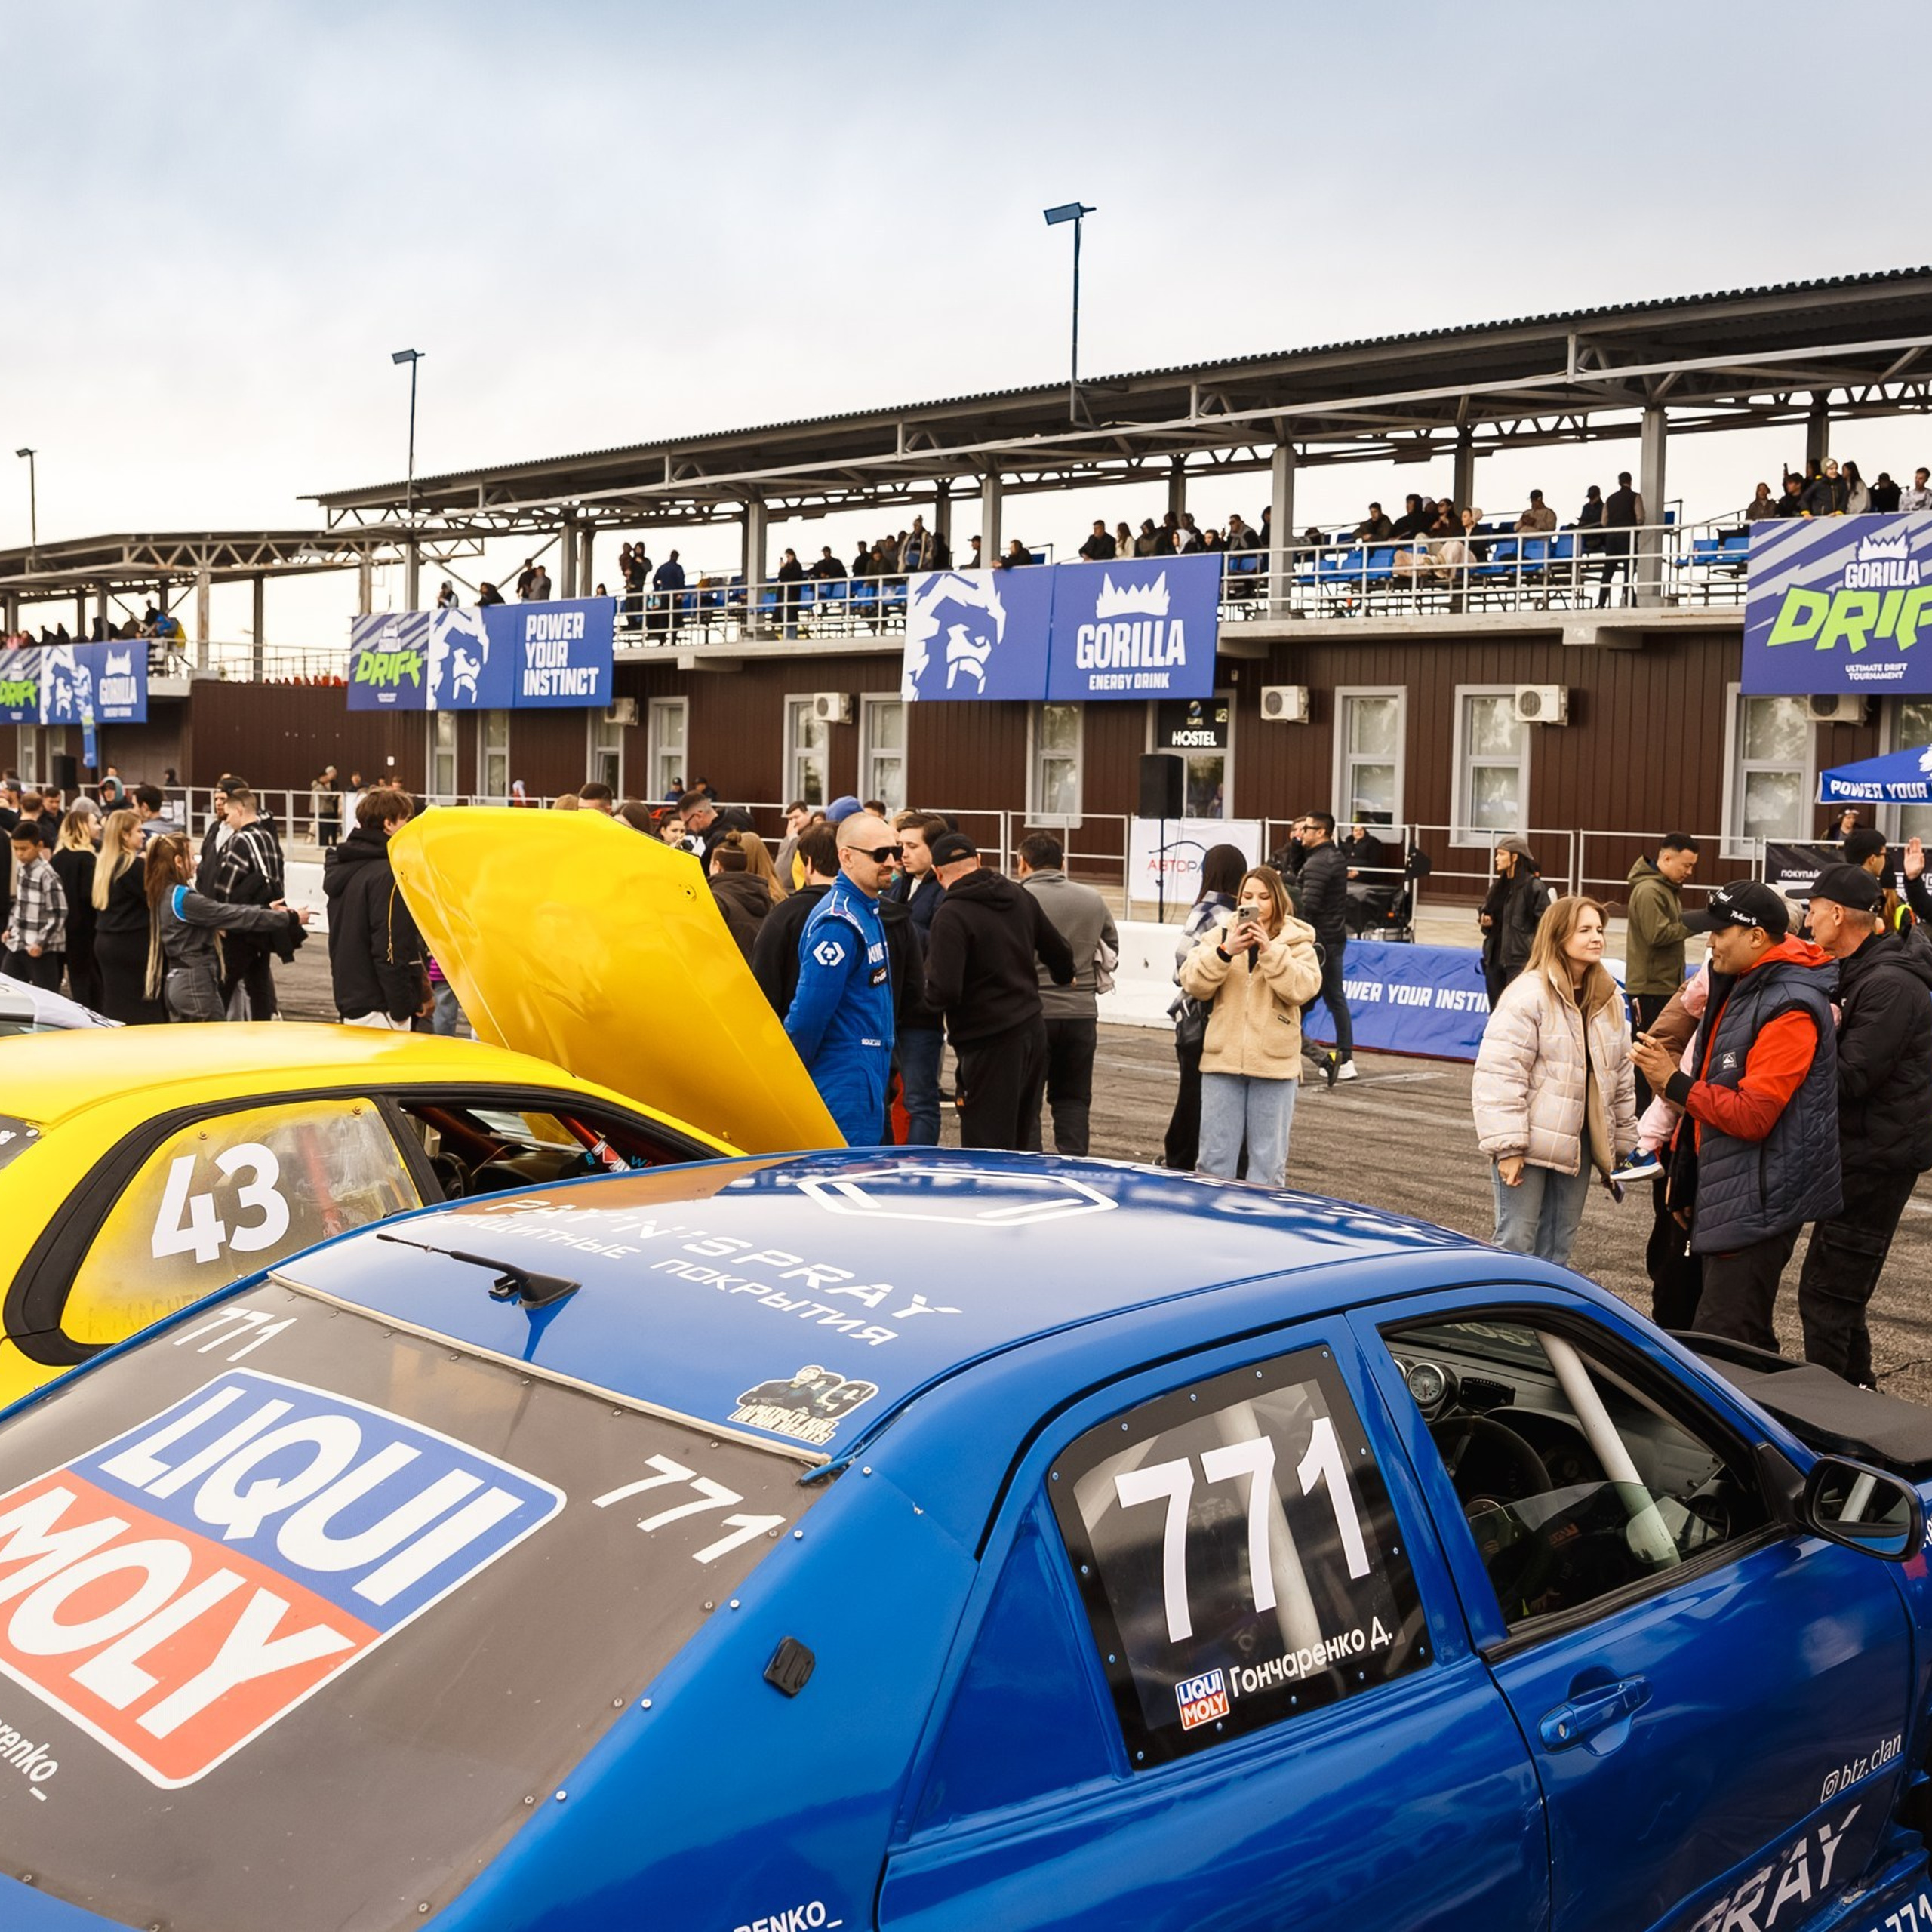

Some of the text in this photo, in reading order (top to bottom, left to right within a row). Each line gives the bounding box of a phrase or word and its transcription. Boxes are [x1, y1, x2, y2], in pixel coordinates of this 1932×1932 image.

[1845, 559, 1920, 589] GORILLA
[526, 612, 585, 640] POWER
[525, 641, 568, 668] YOUR
[1076, 619, 1186, 669] GORILLA
[355, 649, 423, 688] DRIFT
[523, 667, 599, 696] INSTINCT
[1089, 672, 1170, 691] ENERGY DRINK
[1845, 663, 1908, 673] ULTIMATE DRIFT
[1848, 671, 1904, 681] TOURNAMENT
[1171, 730, 1217, 746] HOSTEL
[1830, 780, 1928, 800] POWER YOUR
[1387, 983, 1433, 1008] YOUR
[152, 1143, 291, 1264] 43
[650, 1258, 899, 1346] ПОКРЫТИЯ
[174, 1306, 297, 1361] 771
[97, 1385, 525, 1607] LIQUI
[592, 1454, 786, 1564] 771
[1114, 1416, 1371, 1644] 771
[0, 1486, 357, 1740] MOLY
[1229, 1616, 1393, 1697] Гончаренко Д.
[1179, 1672, 1222, 1704] LIQUI
[1184, 1693, 1225, 1725] MOLY
[0, 1719, 59, 1801] renko_
[1839, 1734, 1902, 1791] btz.clan
